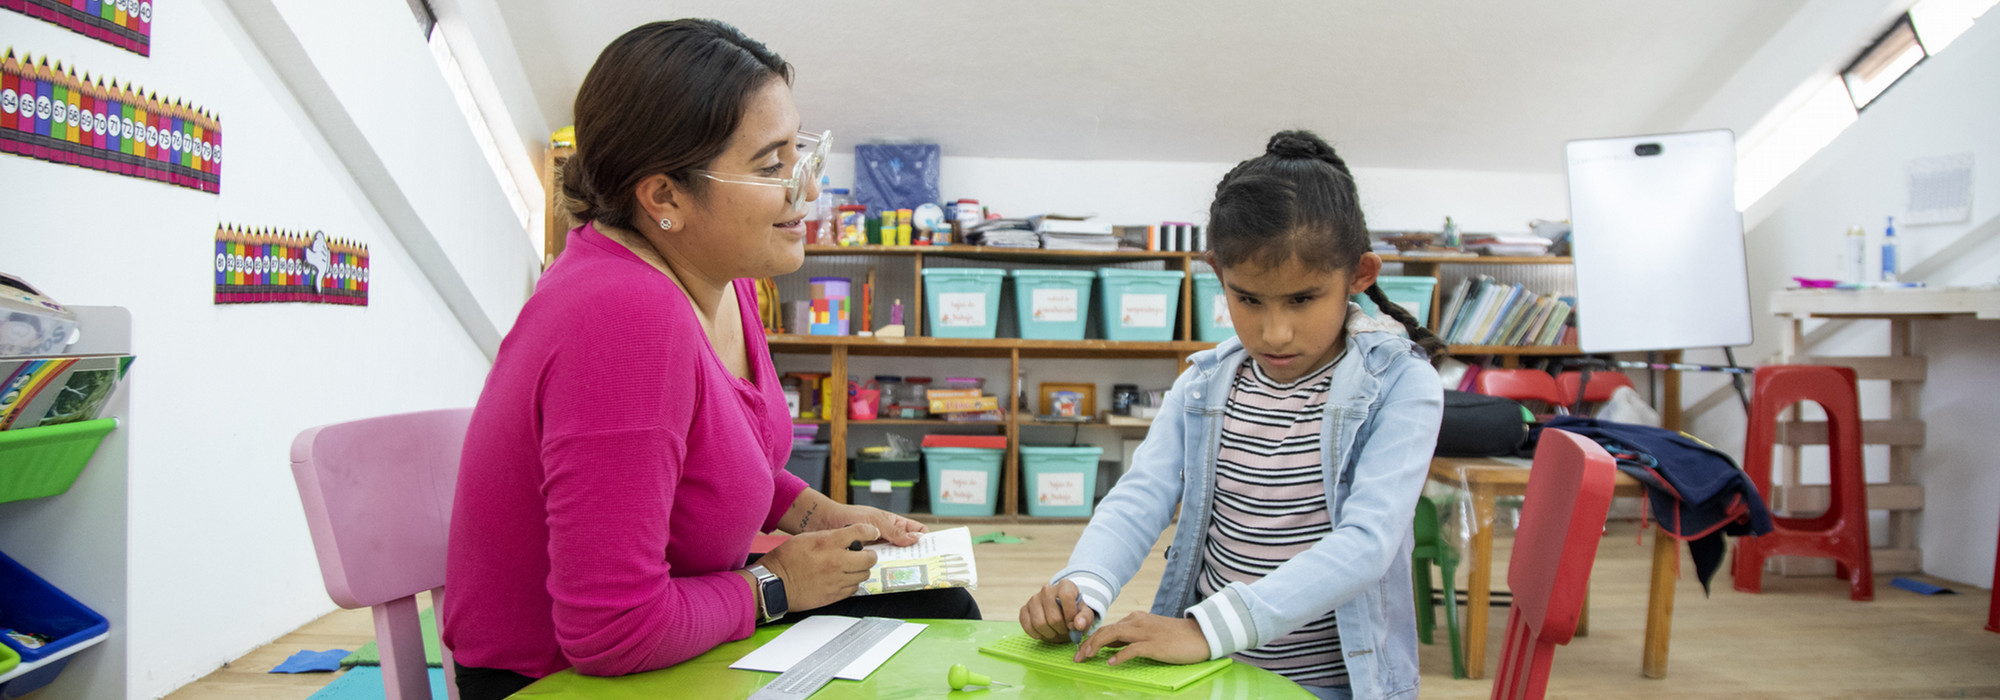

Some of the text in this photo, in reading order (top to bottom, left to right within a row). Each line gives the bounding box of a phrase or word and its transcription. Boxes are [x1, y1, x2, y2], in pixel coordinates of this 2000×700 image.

[129, 0, 138, 13] 39
[140, 6, 152, 19] 40
[3, 94, 16, 109] 64
[22, 98, 34, 113] 65
[38, 101, 50, 115] 66
[54, 104, 65, 118] 67
[69, 109, 79, 122] 68
[81, 114, 92, 127] 69
[94, 117, 106, 131] 70
[110, 119, 119, 132] 71
[123, 121, 132, 135] 72
[135, 125, 144, 138] 73
[147, 129, 156, 142] 74
[160, 133, 169, 145] 75
[172, 134, 181, 144] 76
[183, 137, 192, 148] 77
[193, 141, 201, 150] 78
[203, 146, 211, 157] 79
